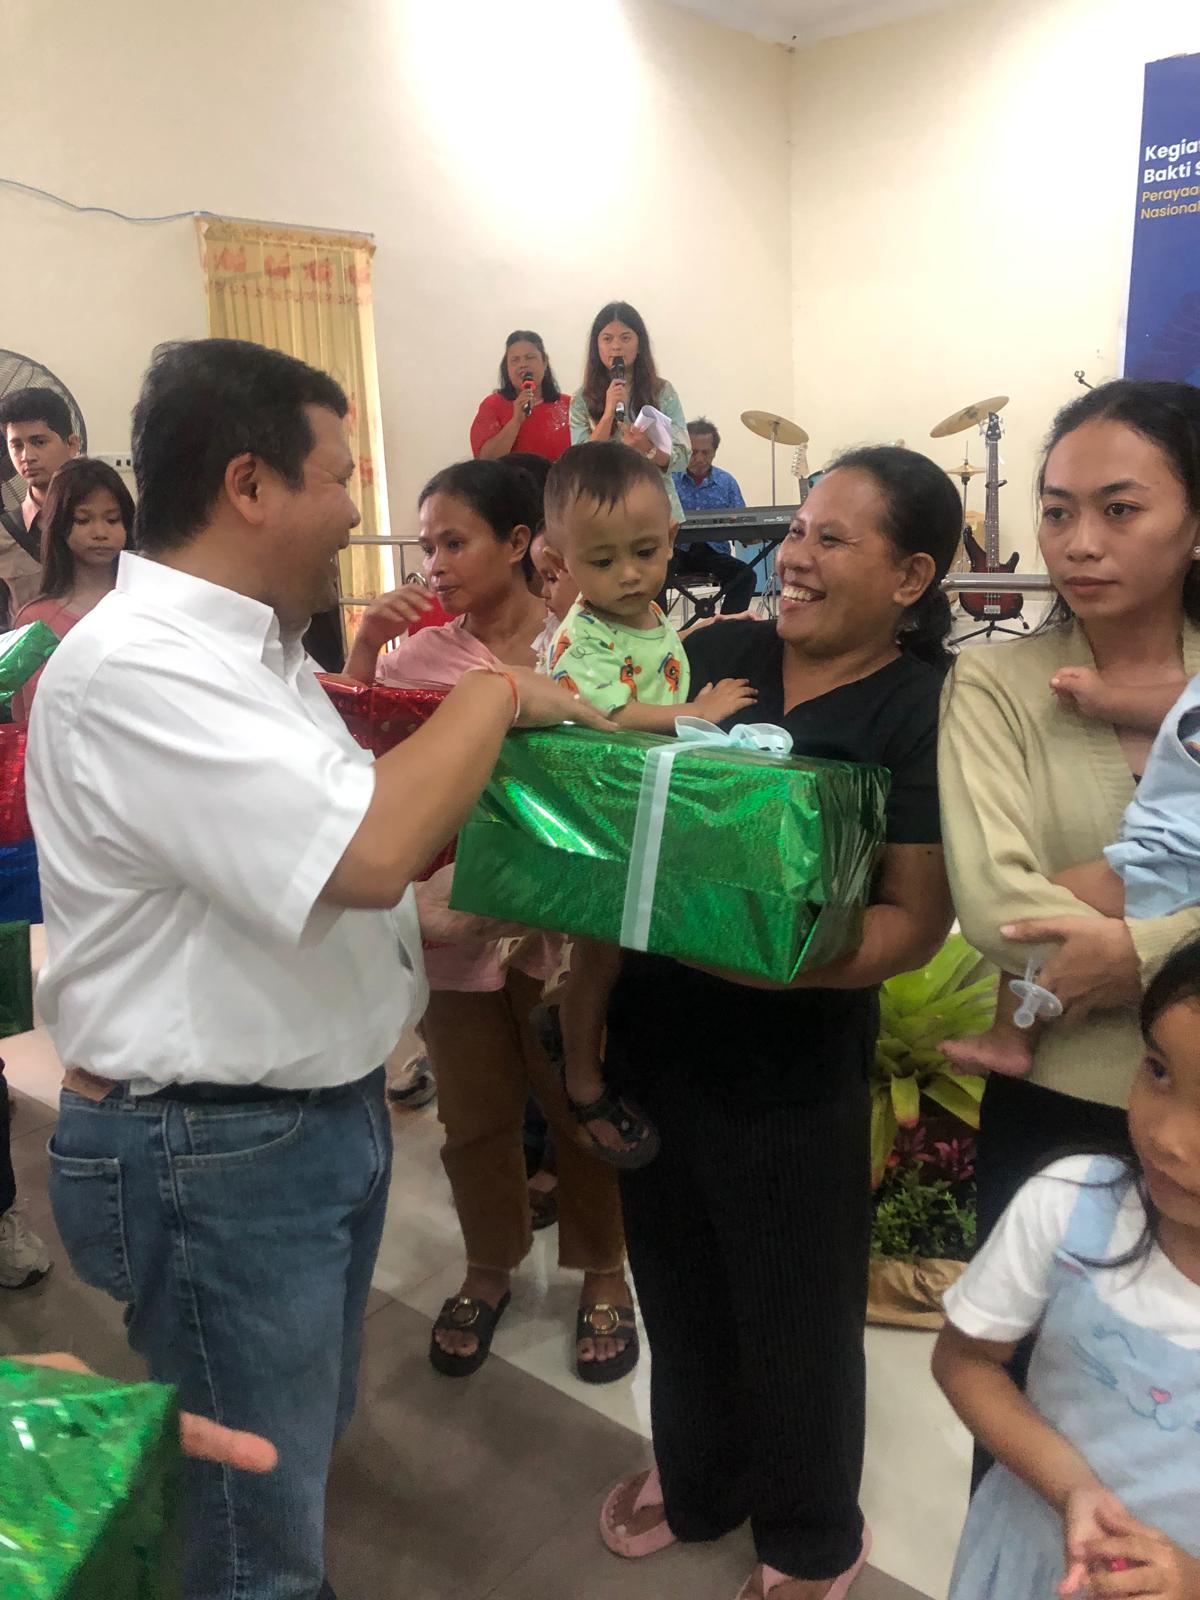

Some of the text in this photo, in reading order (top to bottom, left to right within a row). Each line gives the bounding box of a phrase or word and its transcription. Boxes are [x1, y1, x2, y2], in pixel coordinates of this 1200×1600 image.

[1145, 138, 1200, 162] Kegia
[1143, 161, 1191, 184] Bakti
[1142, 185, 1200, 203] Perayaa
